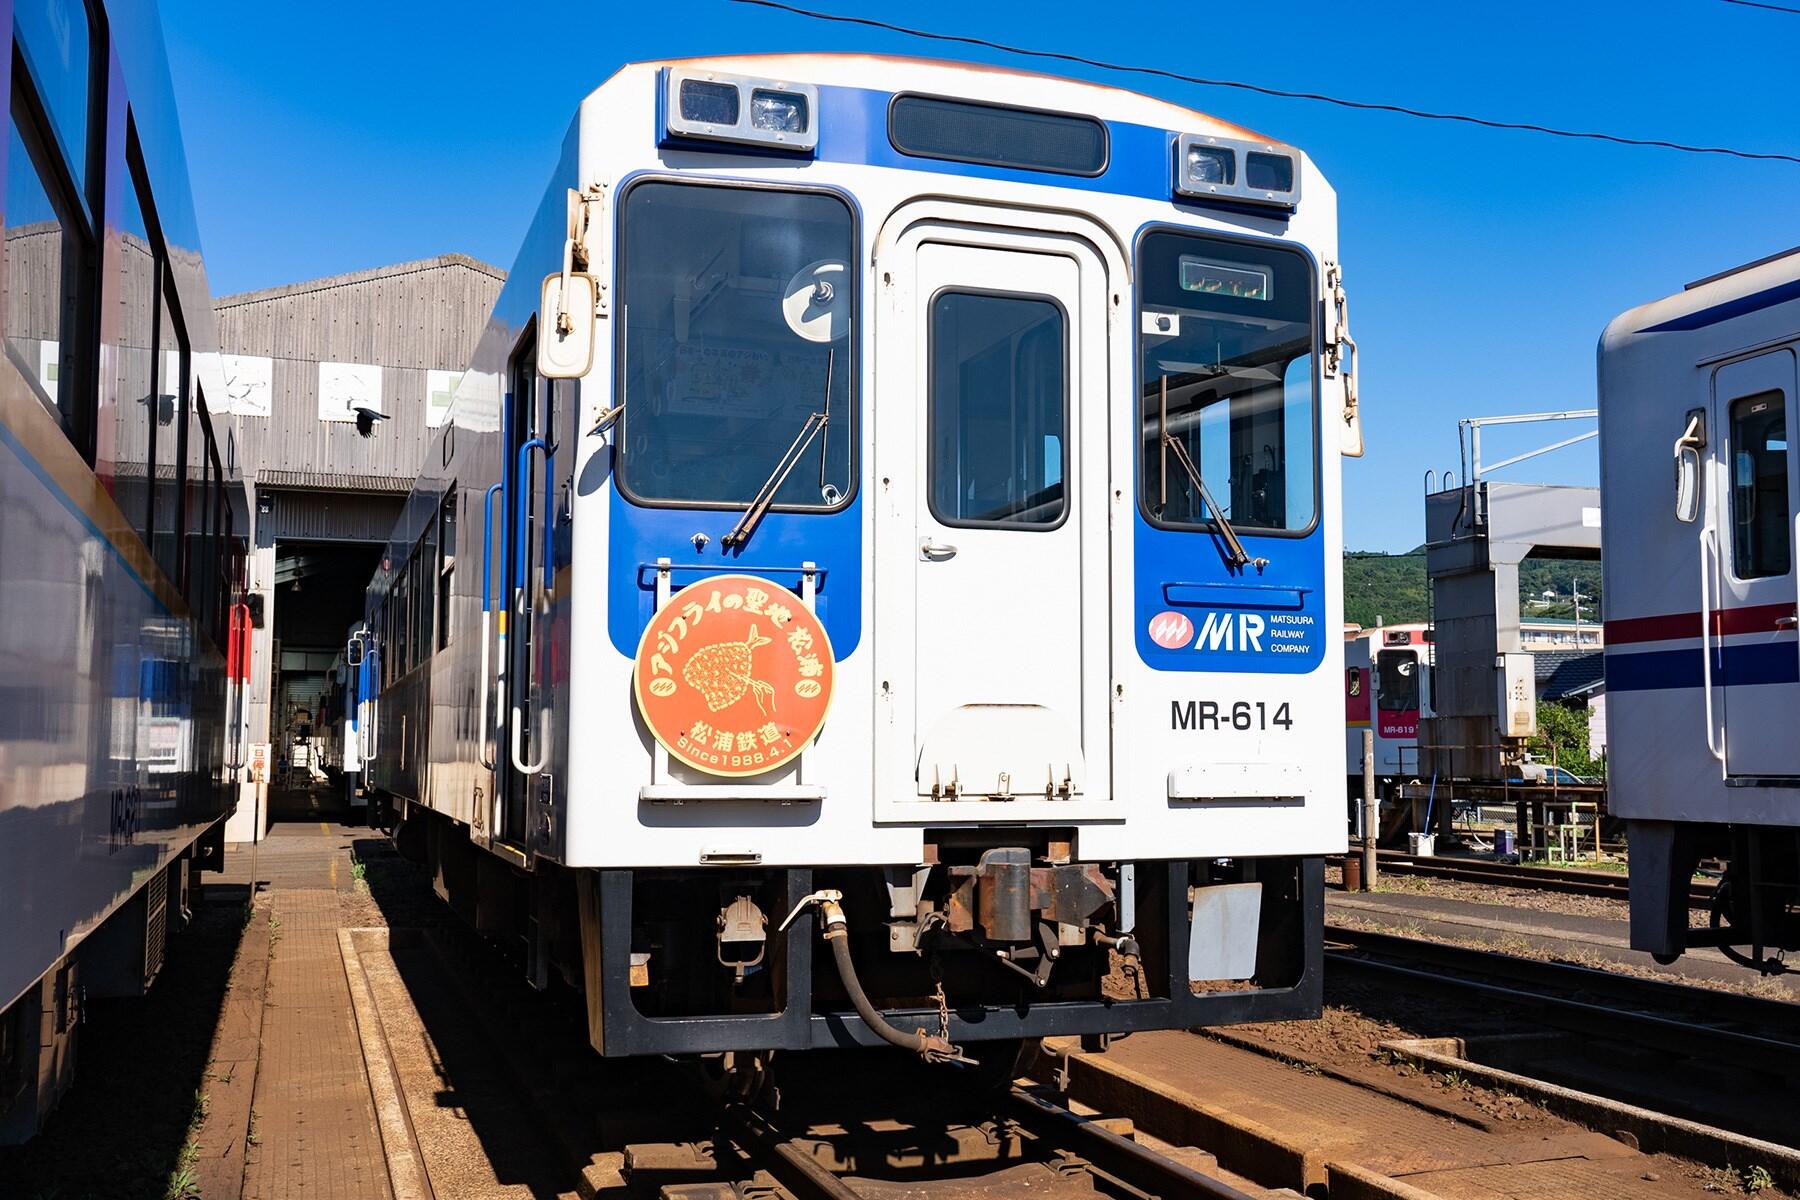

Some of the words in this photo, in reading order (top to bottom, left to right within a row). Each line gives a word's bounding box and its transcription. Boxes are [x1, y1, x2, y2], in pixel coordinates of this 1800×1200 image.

[1270, 615, 1314, 625] MATSUURA
[650, 587, 792, 675] アジフライの聖地
[1193, 612, 1265, 652] MR
[1270, 629, 1305, 639] RAILWAY
[1270, 643, 1311, 653] COMPANY
[1171, 700, 1293, 730] MR-614
[689, 719, 782, 752] 松浦鉄道
[1383, 725, 1415, 734] MR-619
